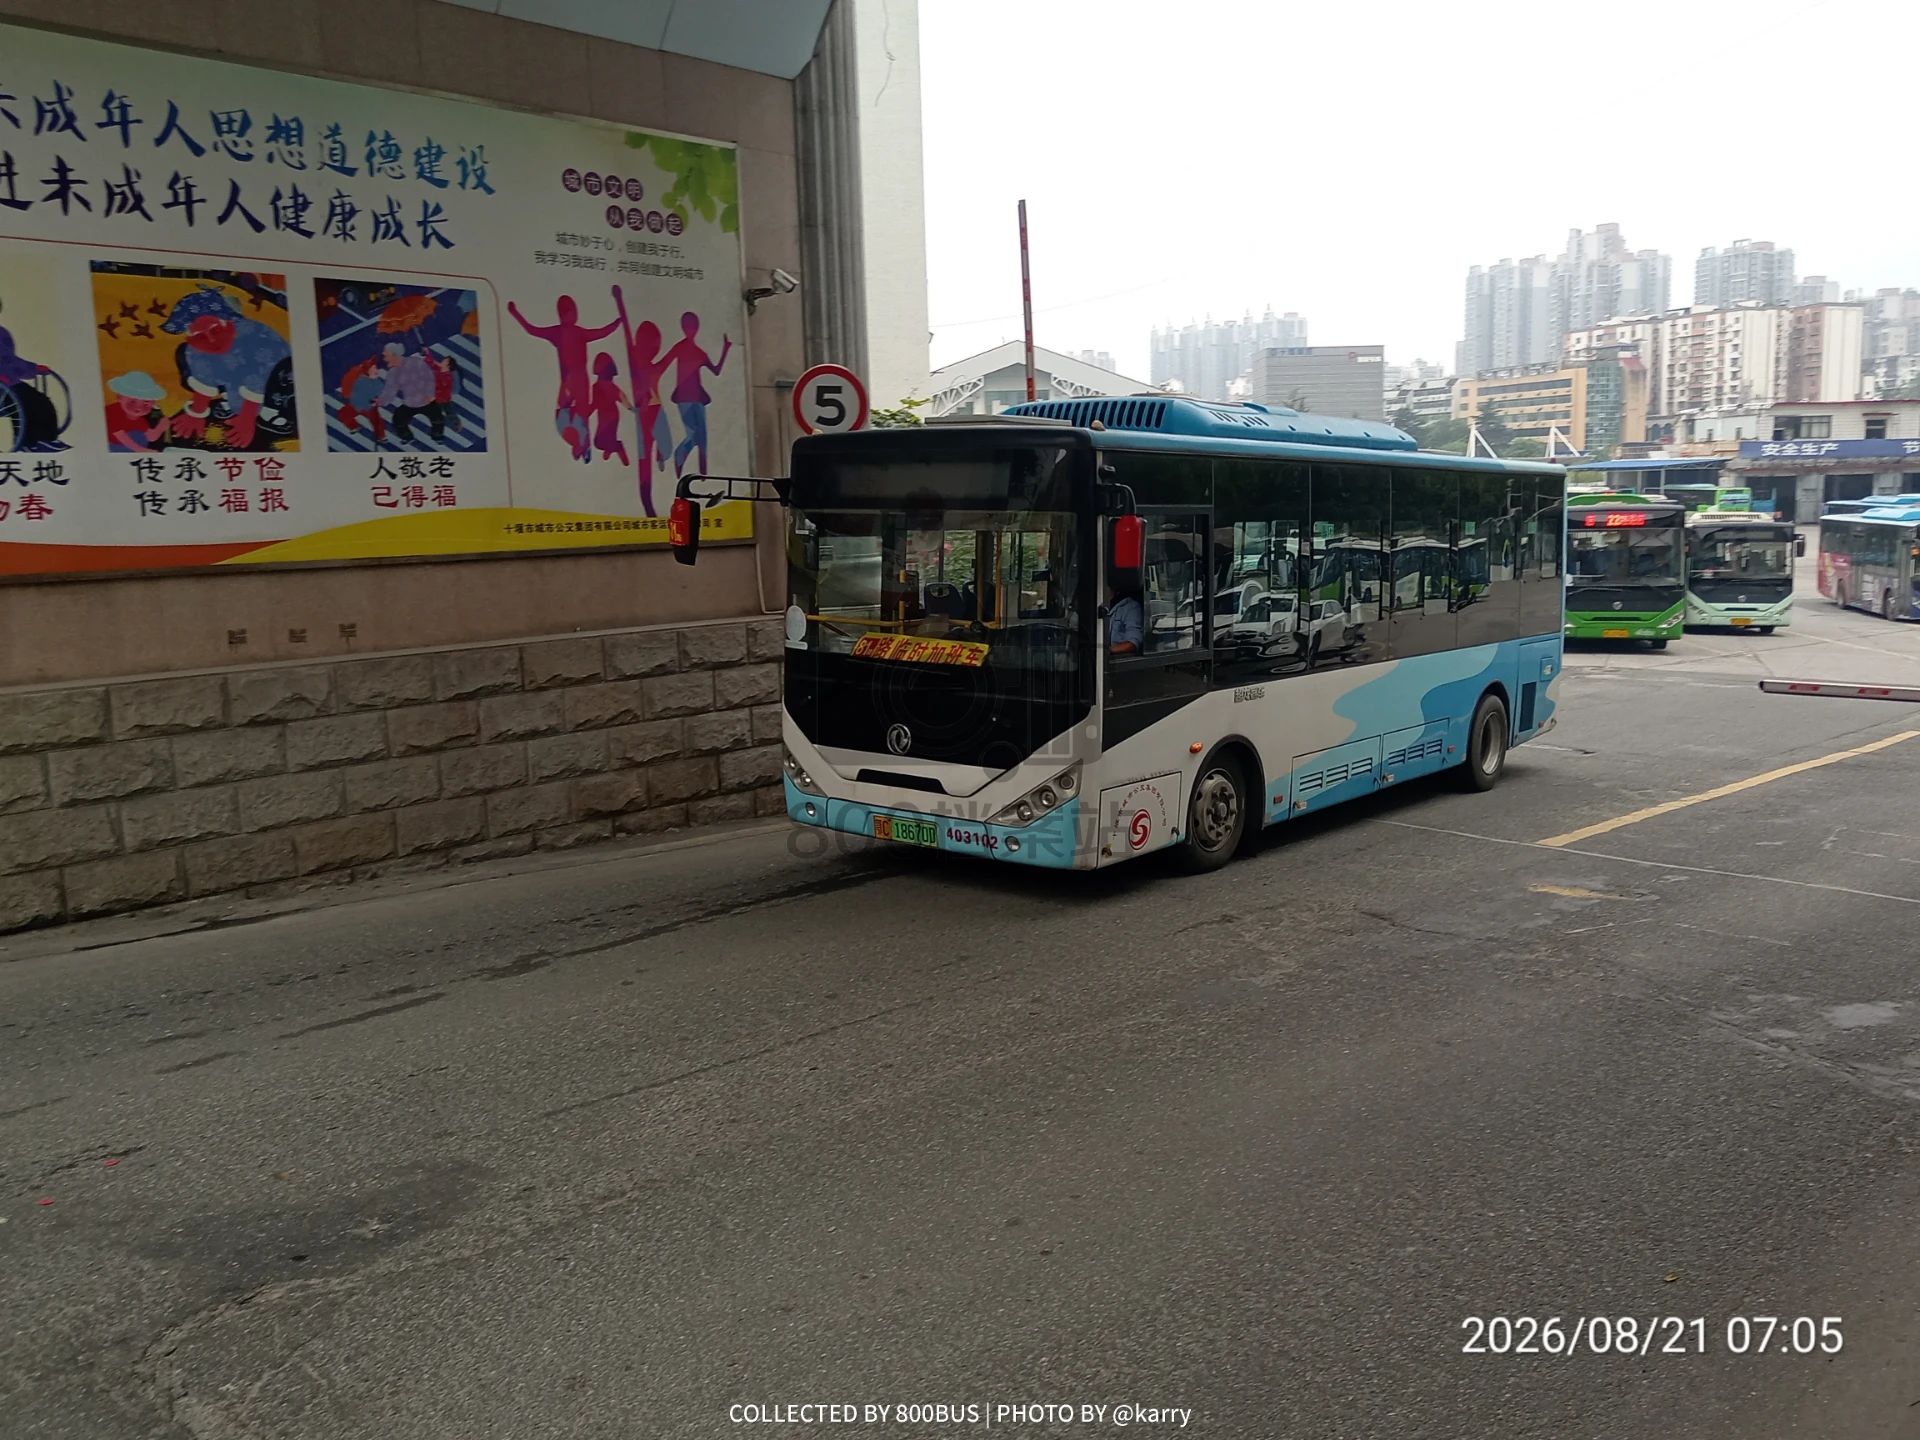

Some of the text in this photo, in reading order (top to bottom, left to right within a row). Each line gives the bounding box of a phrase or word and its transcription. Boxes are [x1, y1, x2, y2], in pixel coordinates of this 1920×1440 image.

[563, 169, 643, 201] 城市文明
[815, 386, 846, 426] 5
[1761, 442, 1840, 457] 安全生产
[369, 456, 455, 479] 人敬老
[133, 488, 289, 516] 传承福报
[946, 827, 999, 849] 403102
